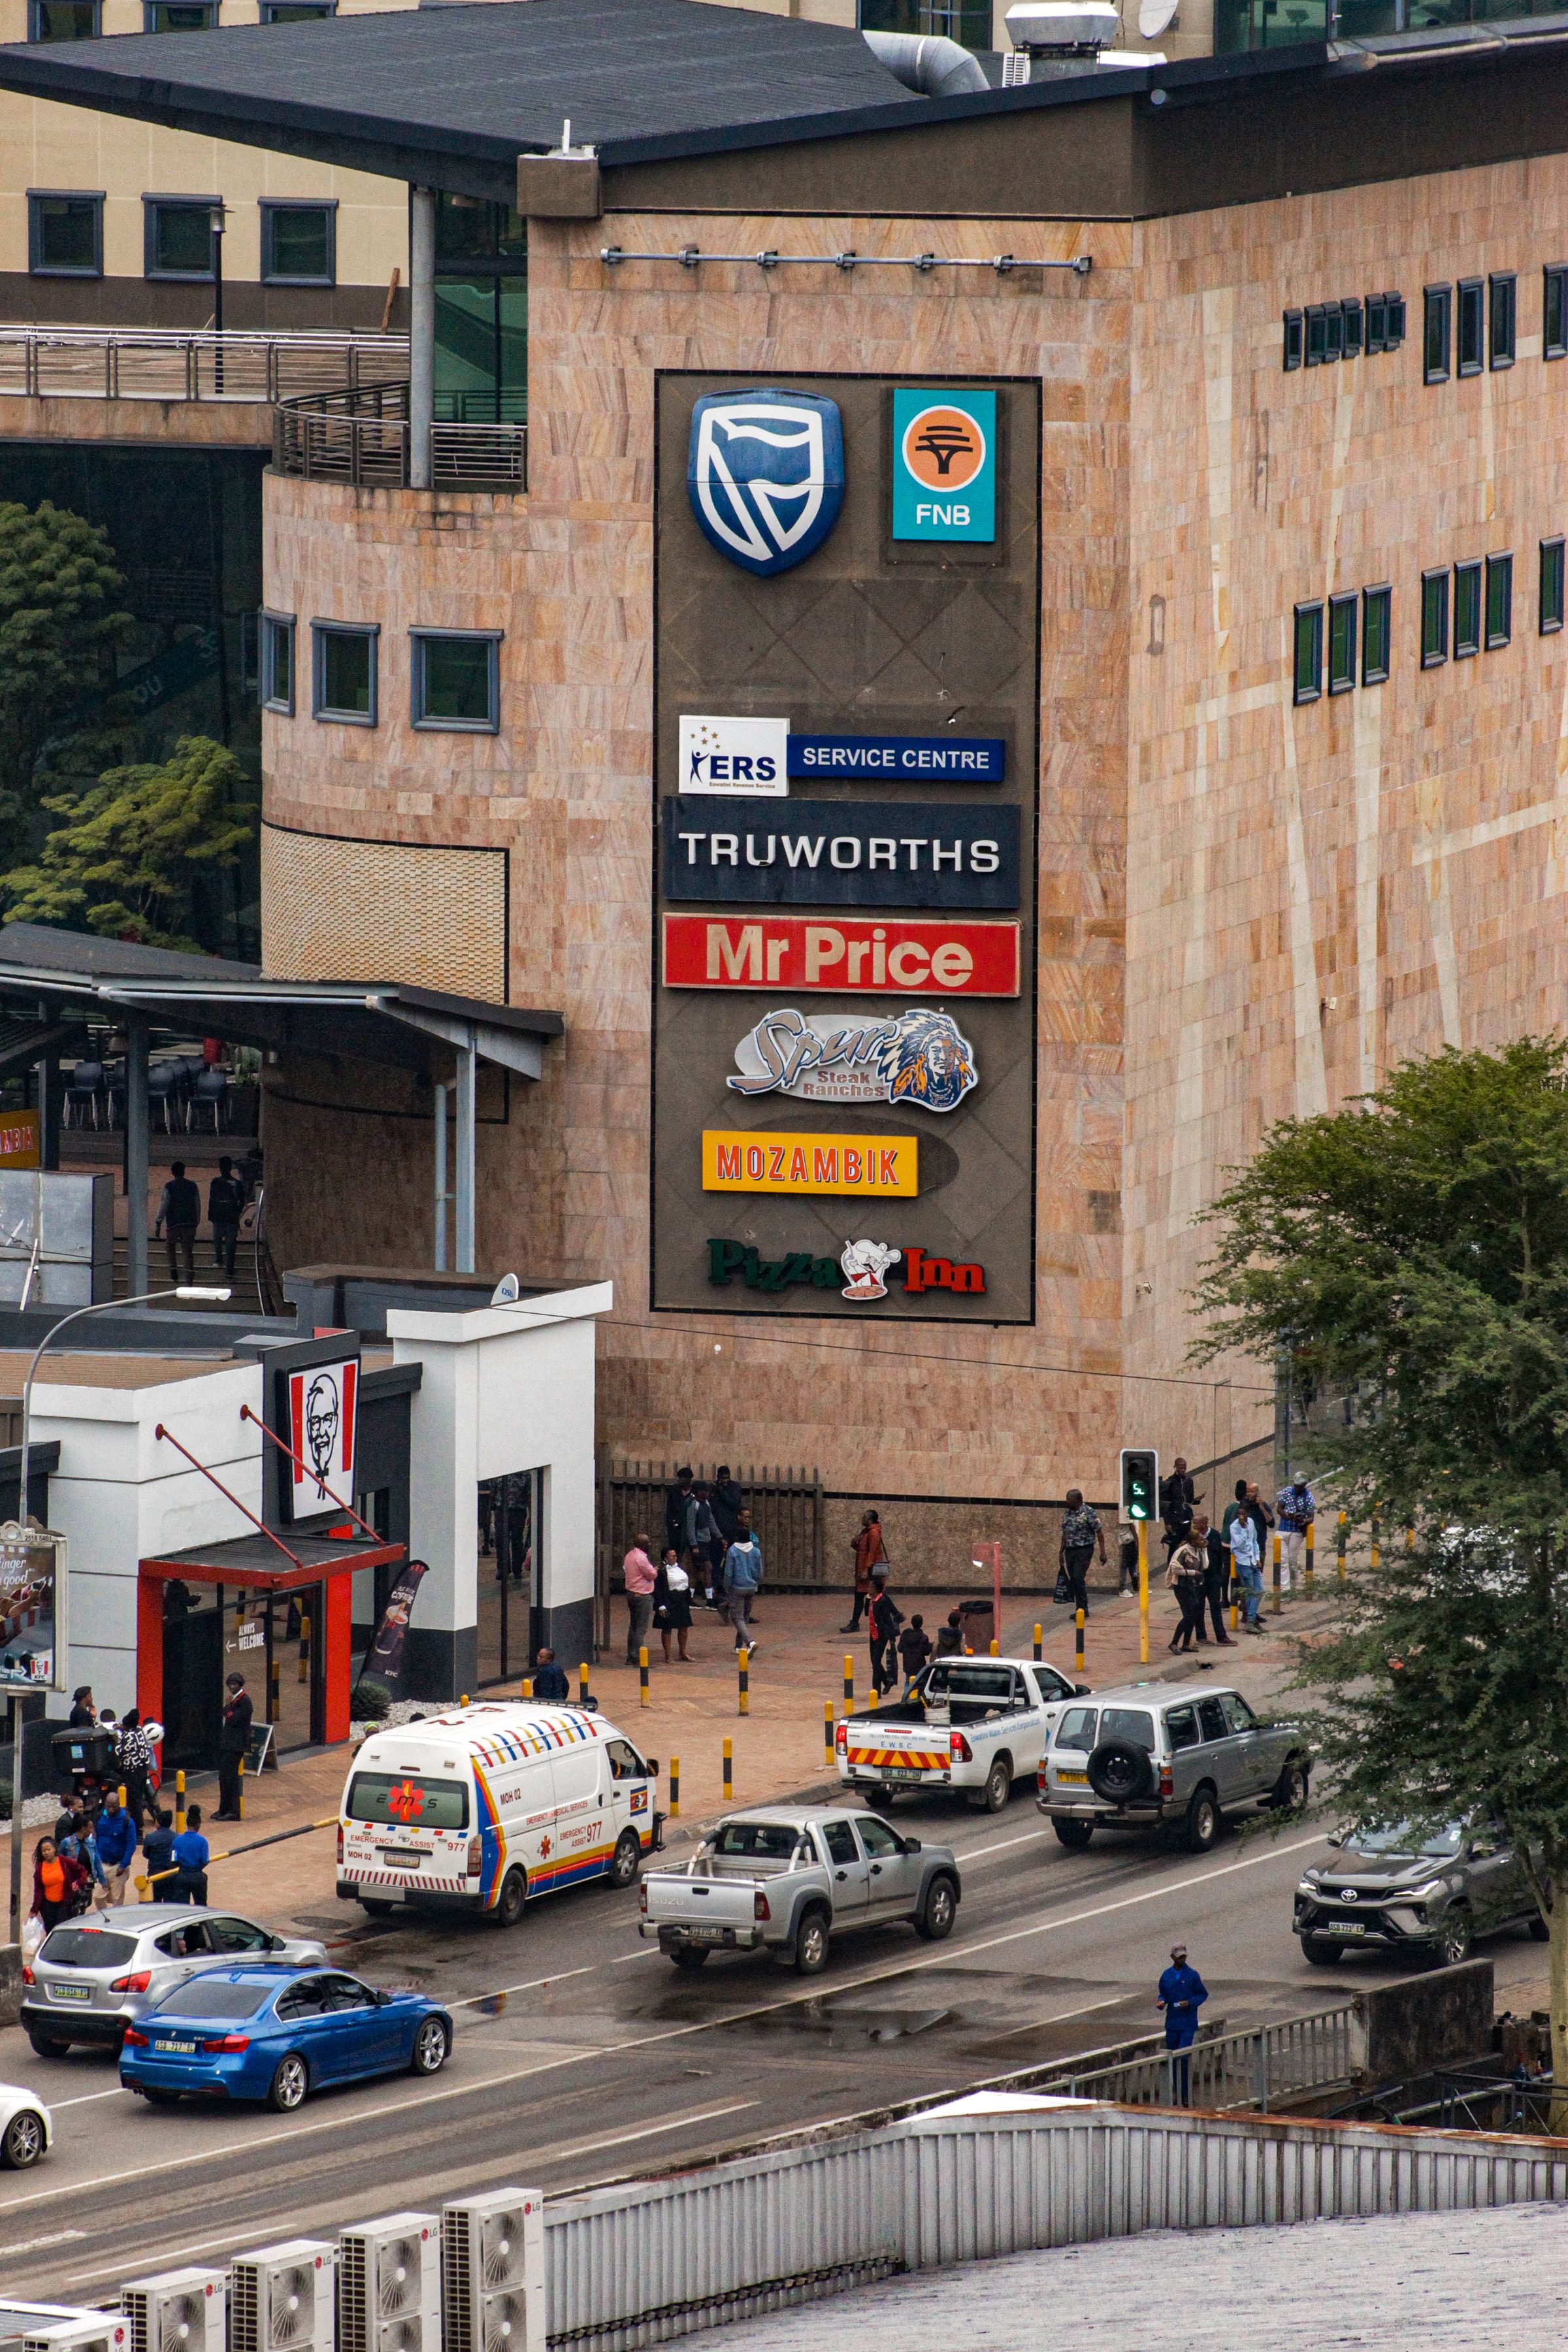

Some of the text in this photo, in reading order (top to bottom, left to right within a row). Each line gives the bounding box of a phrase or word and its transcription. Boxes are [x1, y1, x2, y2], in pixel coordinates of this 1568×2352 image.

[916, 504, 970, 525] FNB
[803, 747, 989, 769] SERVICE CENTRE
[710, 755, 776, 781] ERS
[678, 833, 1000, 873] TRUWORTHS
[706, 923, 973, 987] Mr Price
[728, 1010, 900, 1093] Spur
[817, 1070, 870, 1085] Steak
[803, 1084, 885, 1097] Ranches
[0, 1126, 33, 1155] MBIK
[716, 1144, 899, 1184] MOZAMBIK
[706, 1238, 986, 1292] Pizza Inn
[238, 1632, 265, 1651] WELCOME
[384, 1669, 399, 1678] KFC
[500, 1788, 521, 1805] MOH 02
[570, 1800, 587, 1812] SERVICES
[560, 1821, 602, 1843] EMERGENCY 977
[350, 1835, 394, 1845] EMERGENCY
[409, 1840, 435, 1849] ASSIST
[448, 1842, 466, 1852] 977
[571, 1837, 586, 1848] ASSIST
[348, 1850, 363, 1859] MOH
[649, 1895, 684, 1906] ISUZU
[171, 2042, 182, 2051] 717
[532, 2202, 540, 2212] LG
[429, 2228, 437, 2238] LG
[323, 2255, 331, 2266] LG
[214, 2283, 222, 2294] LG
